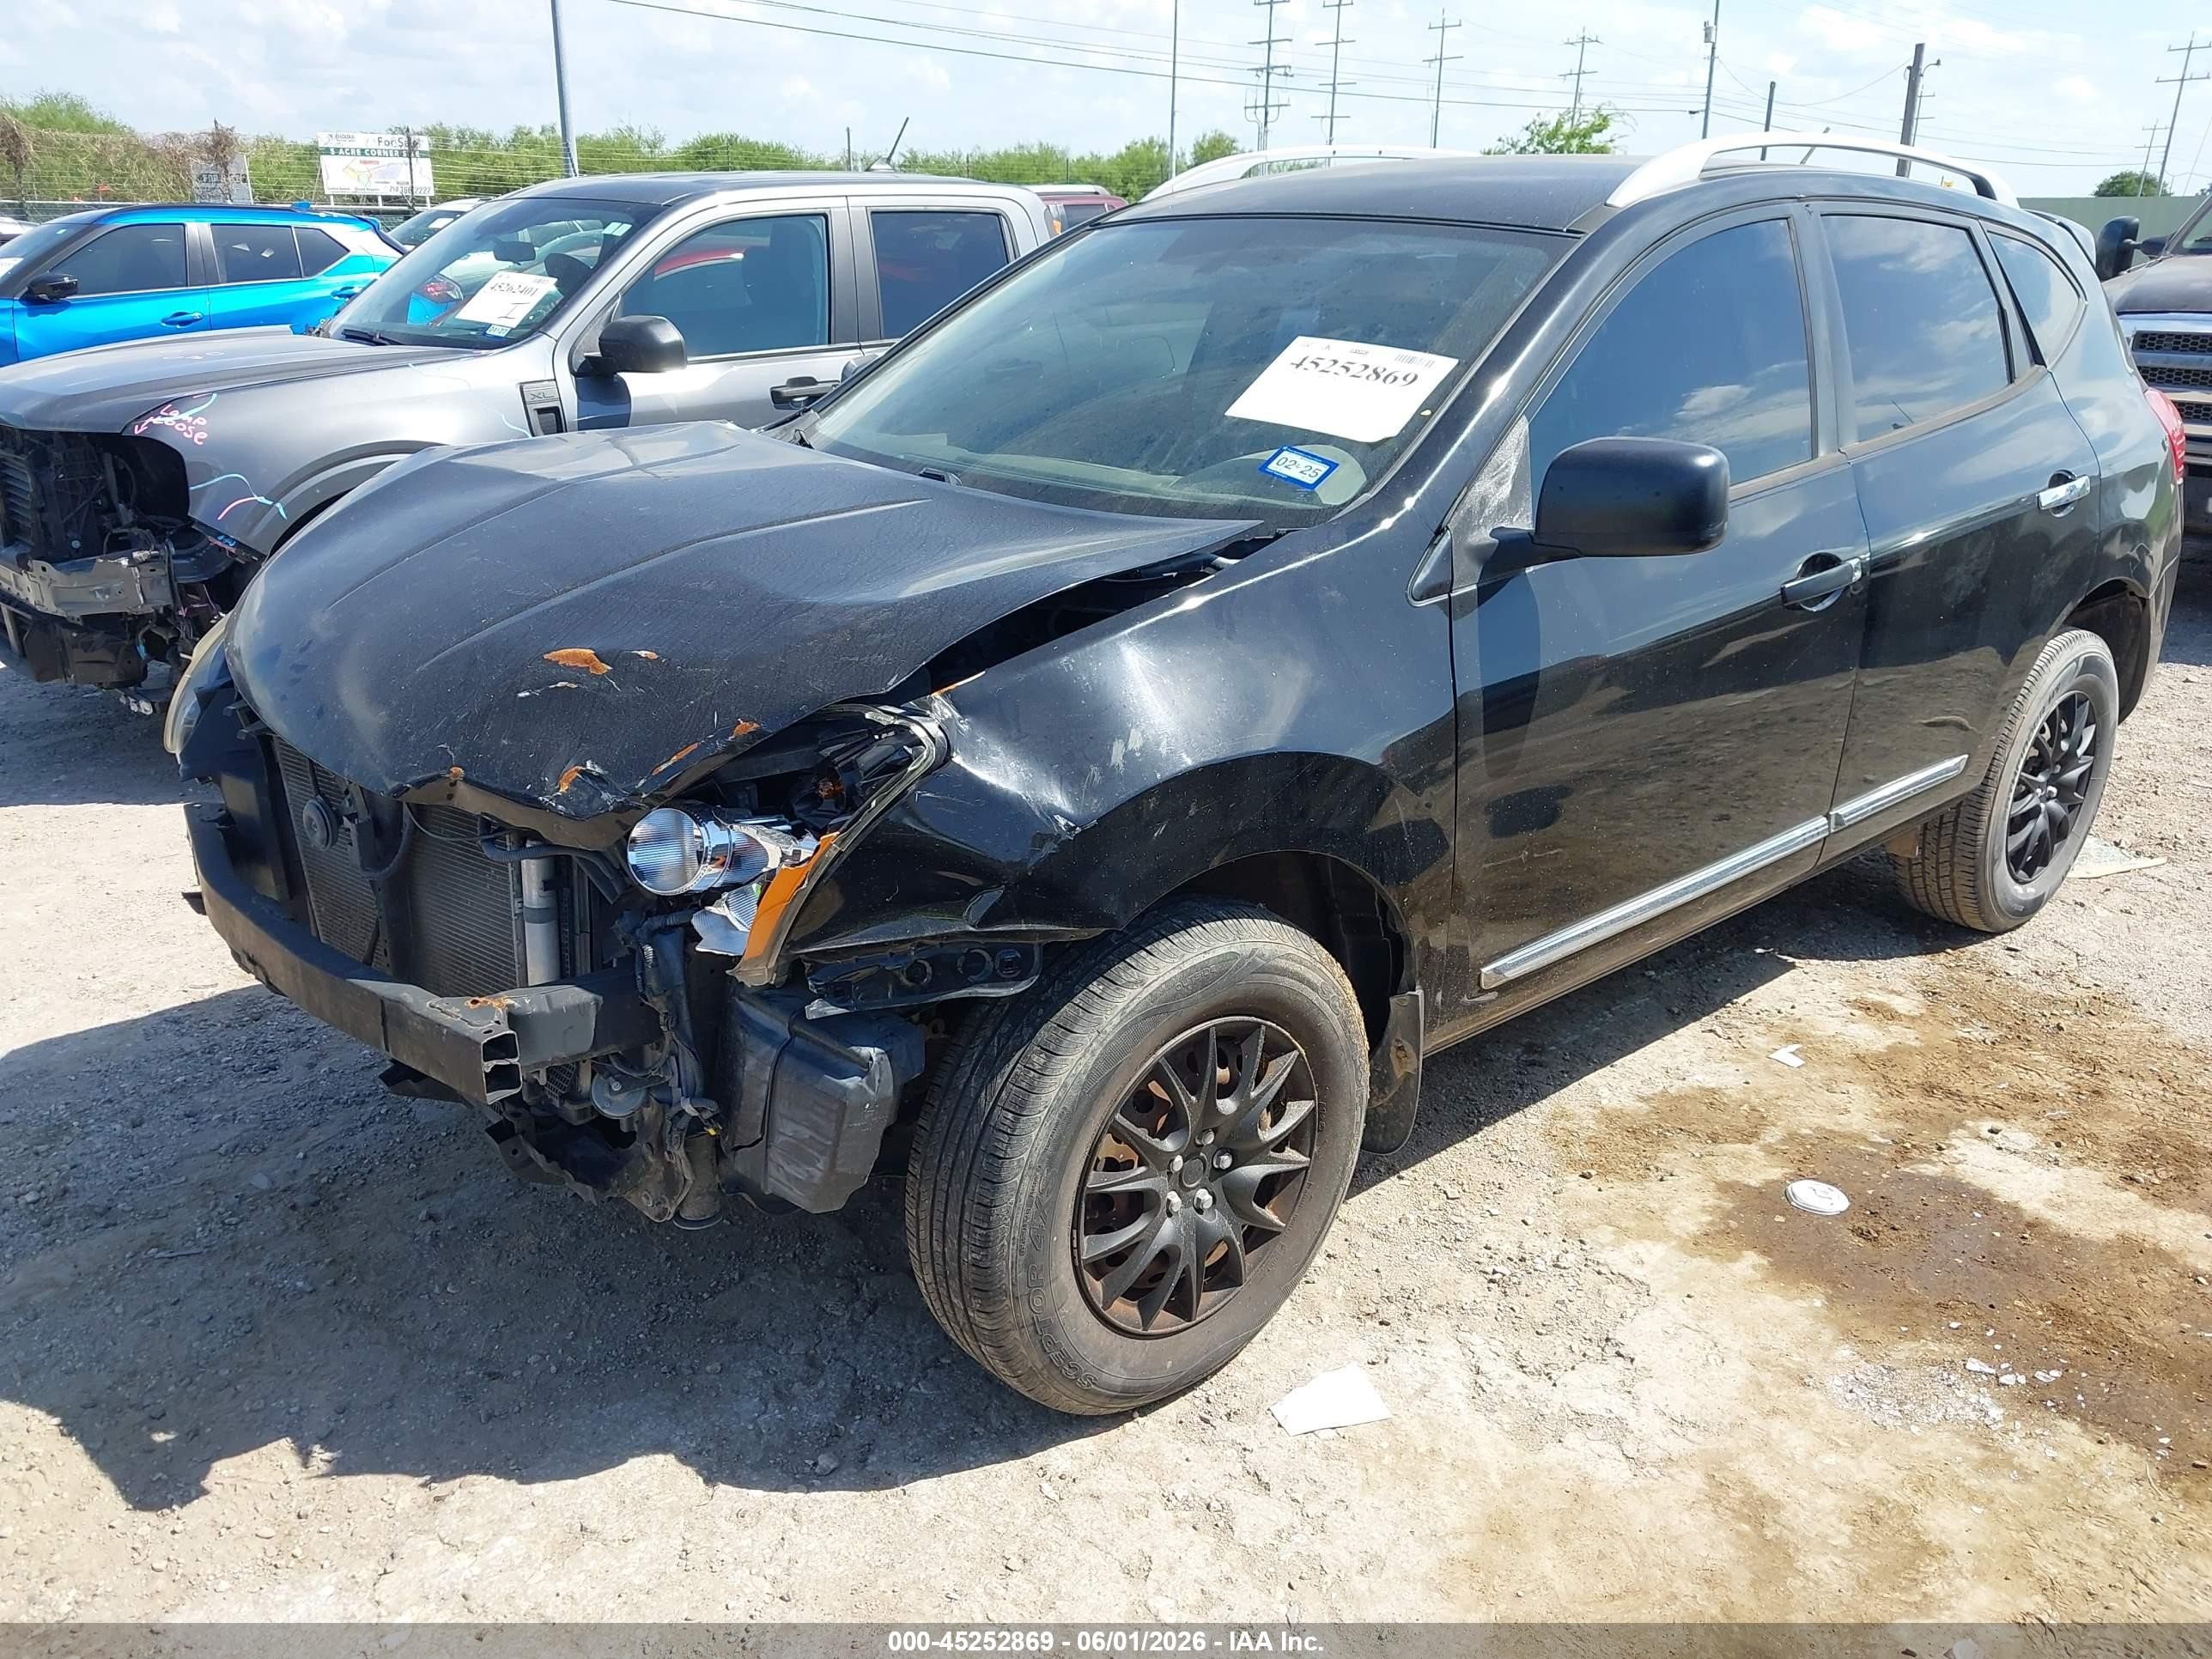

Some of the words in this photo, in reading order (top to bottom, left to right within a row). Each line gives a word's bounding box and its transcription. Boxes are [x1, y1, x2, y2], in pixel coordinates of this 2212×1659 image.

[378, 137, 394, 147] For
[338, 148, 362, 156] ACRE
[365, 149, 399, 157] CORNER
[489, 282, 539, 296] 45262401
[1291, 355, 1419, 387] 45252869
[529, 392, 555, 400] XL
[1175, 964, 1217, 992] OUTSIDE
[1027, 1263, 1099, 1390] SCEPTOR
